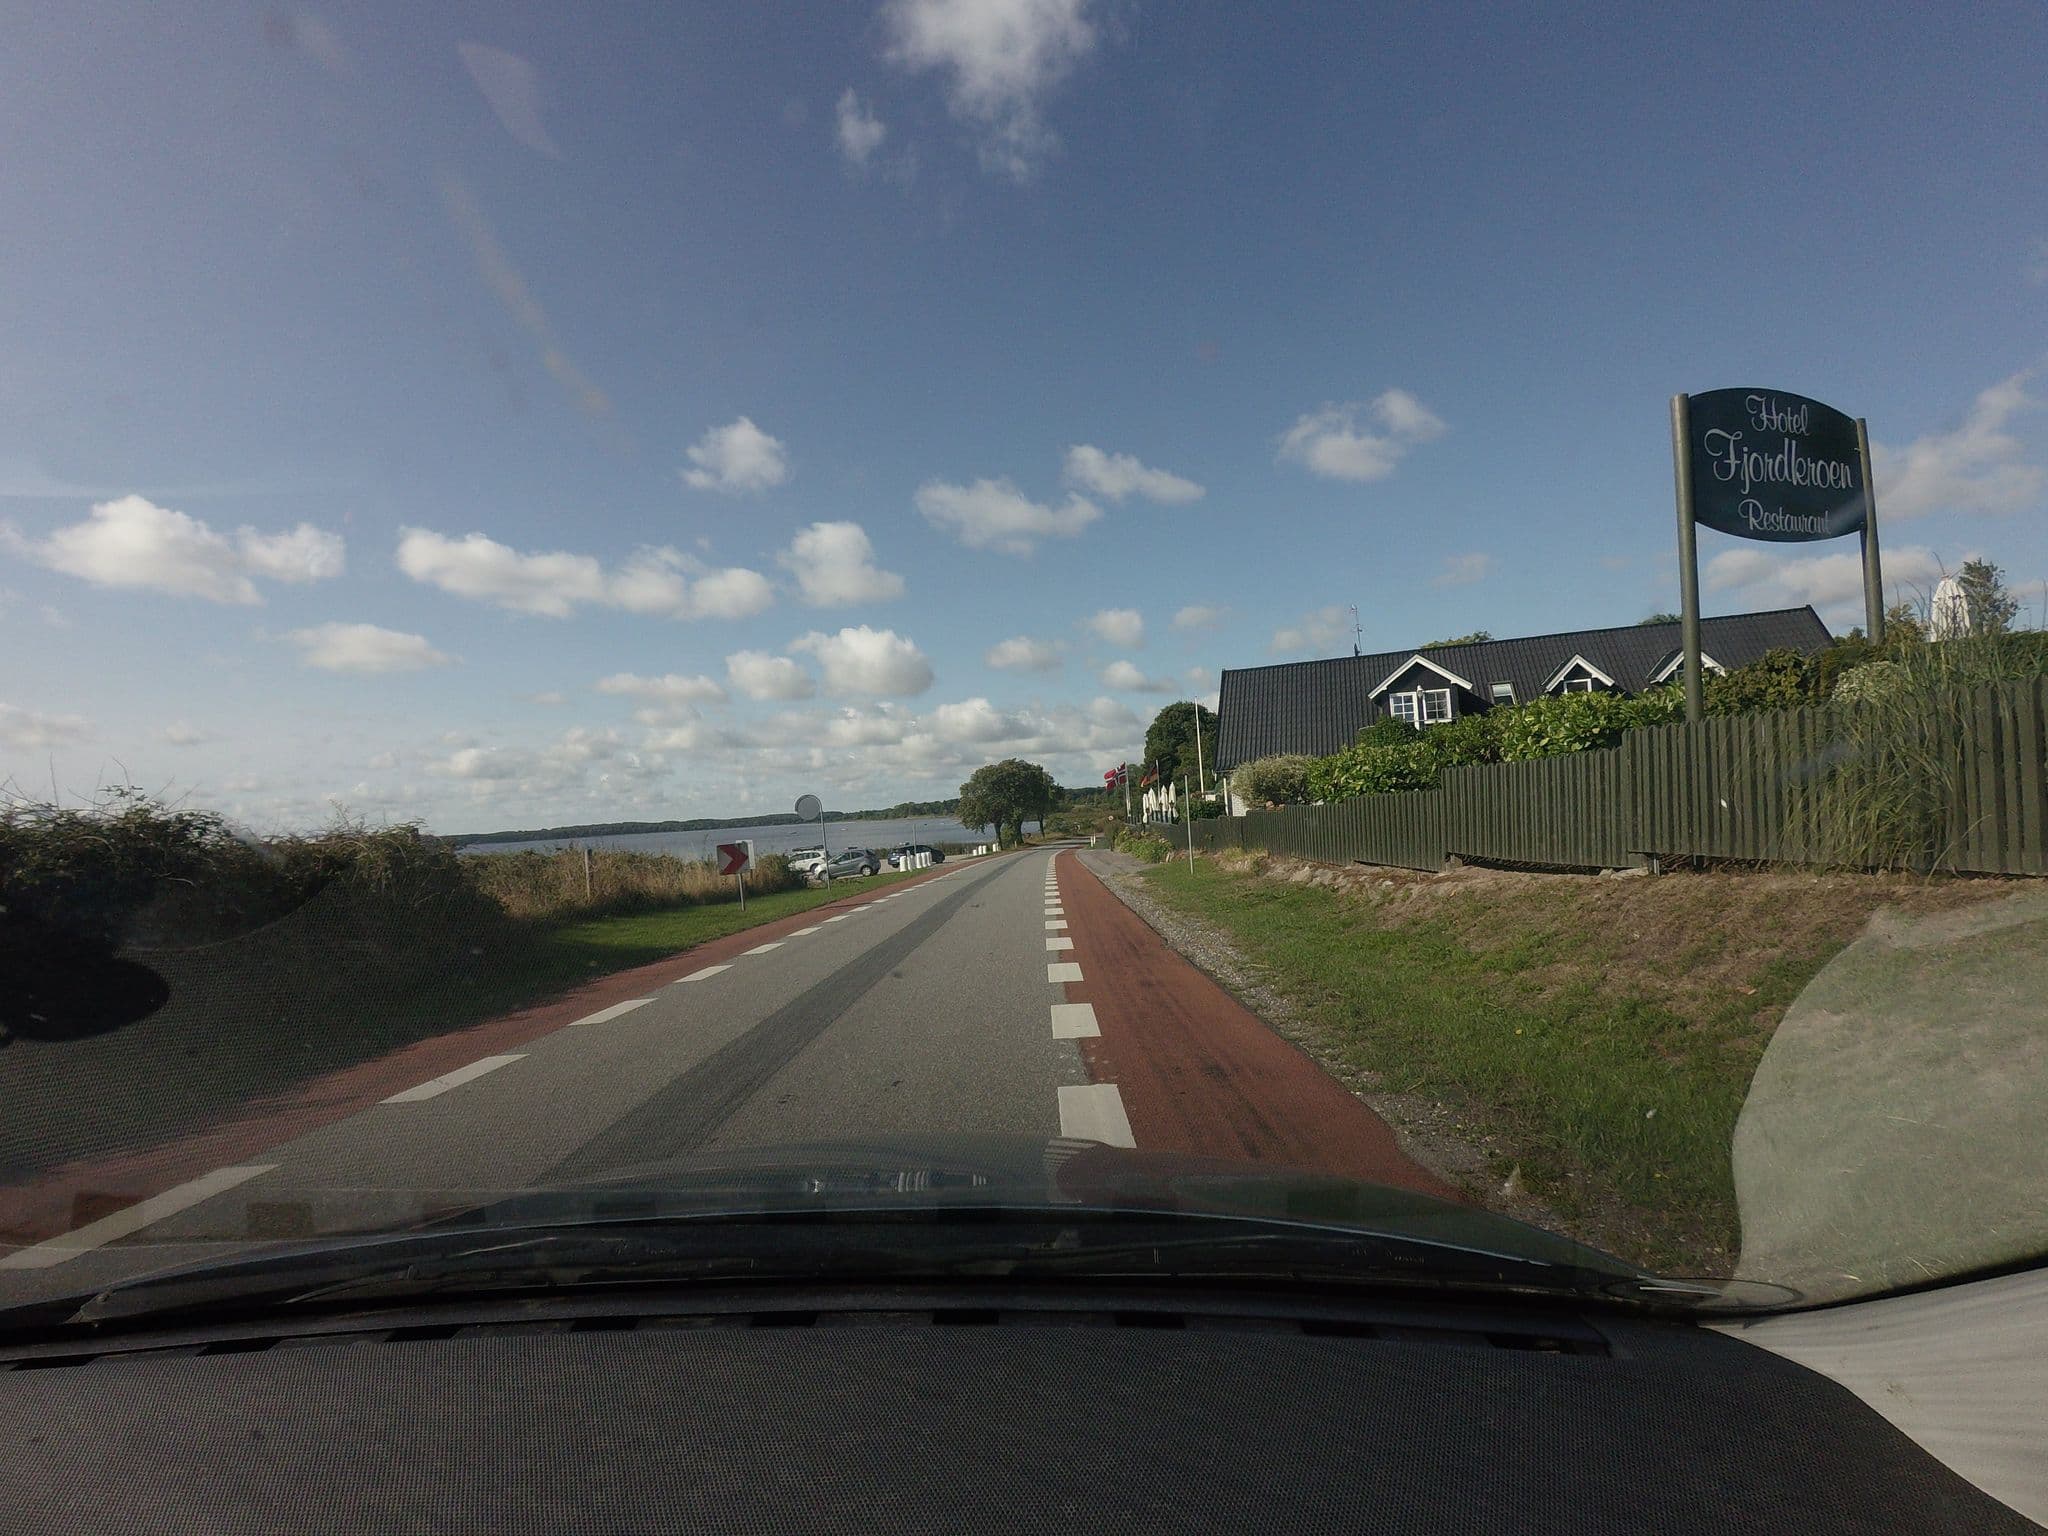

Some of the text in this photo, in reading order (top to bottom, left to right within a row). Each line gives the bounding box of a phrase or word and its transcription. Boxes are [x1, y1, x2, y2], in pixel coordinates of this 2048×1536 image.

[1745, 394, 1810, 436] Hotel
[1704, 428, 1853, 494] Fjordkroen
[1738, 498, 1831, 535] Restaurant
